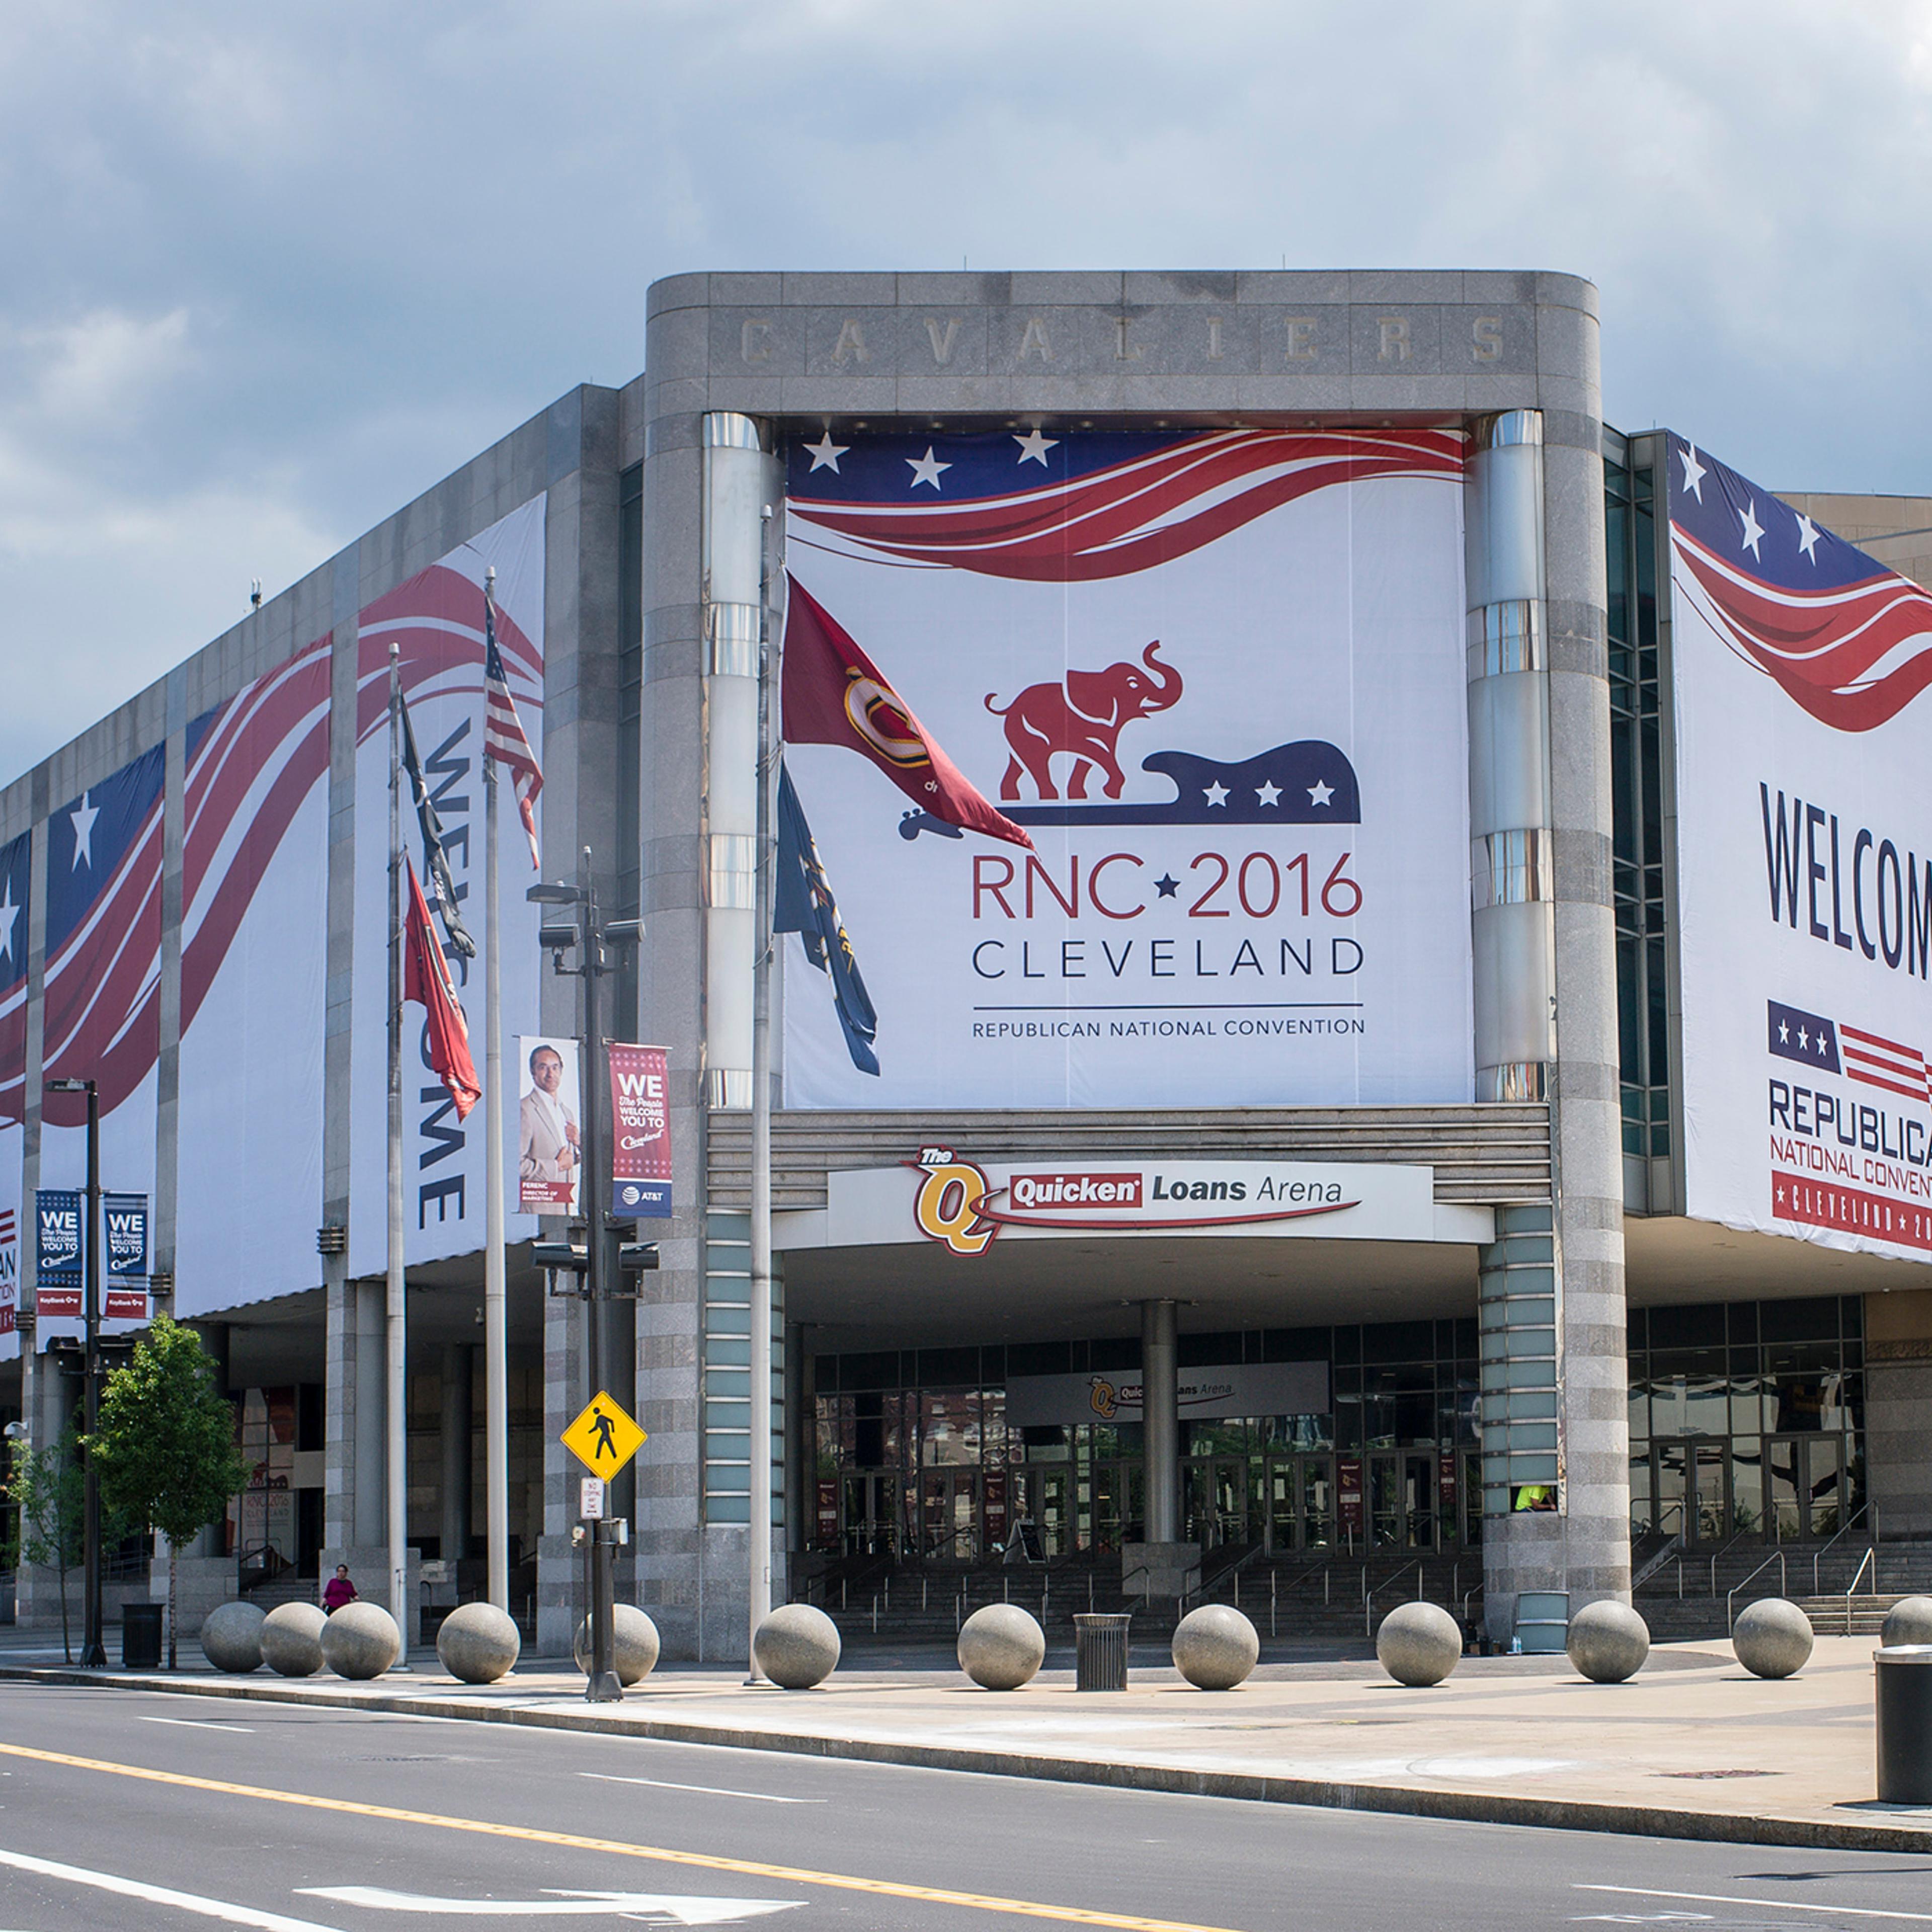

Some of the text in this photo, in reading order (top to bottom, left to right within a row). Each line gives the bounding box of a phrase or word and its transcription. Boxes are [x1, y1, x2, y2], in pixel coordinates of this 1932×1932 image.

[742, 316, 1503, 363] CAVALIERS
[973, 852, 1363, 920] RNC 2016
[972, 938, 1364, 979] CLEVELAND
[973, 1019, 1365, 1037] REPUBLICAN NATIONAL CONVENTION
[617, 1073, 664, 1098] WE
[619, 1106, 664, 1117] WELCOME
[620, 1115, 665, 1128] YOU TO
[921, 1148, 953, 1164] The
[1770, 1134, 1861, 1181] NATIONAL
[641, 1191, 663, 1201] AT&T
[1013, 1175, 1342, 1208] Quicken Loans Arena
[916, 1162, 995, 1254] Q
[41, 1211, 77, 1229] WE
[108, 1214, 143, 1232] WE
[42, 1243, 78, 1251] YOU TO
[110, 1245, 130, 1253] YOU
[1121, 1384, 1232, 1400] Quic ans Arena
